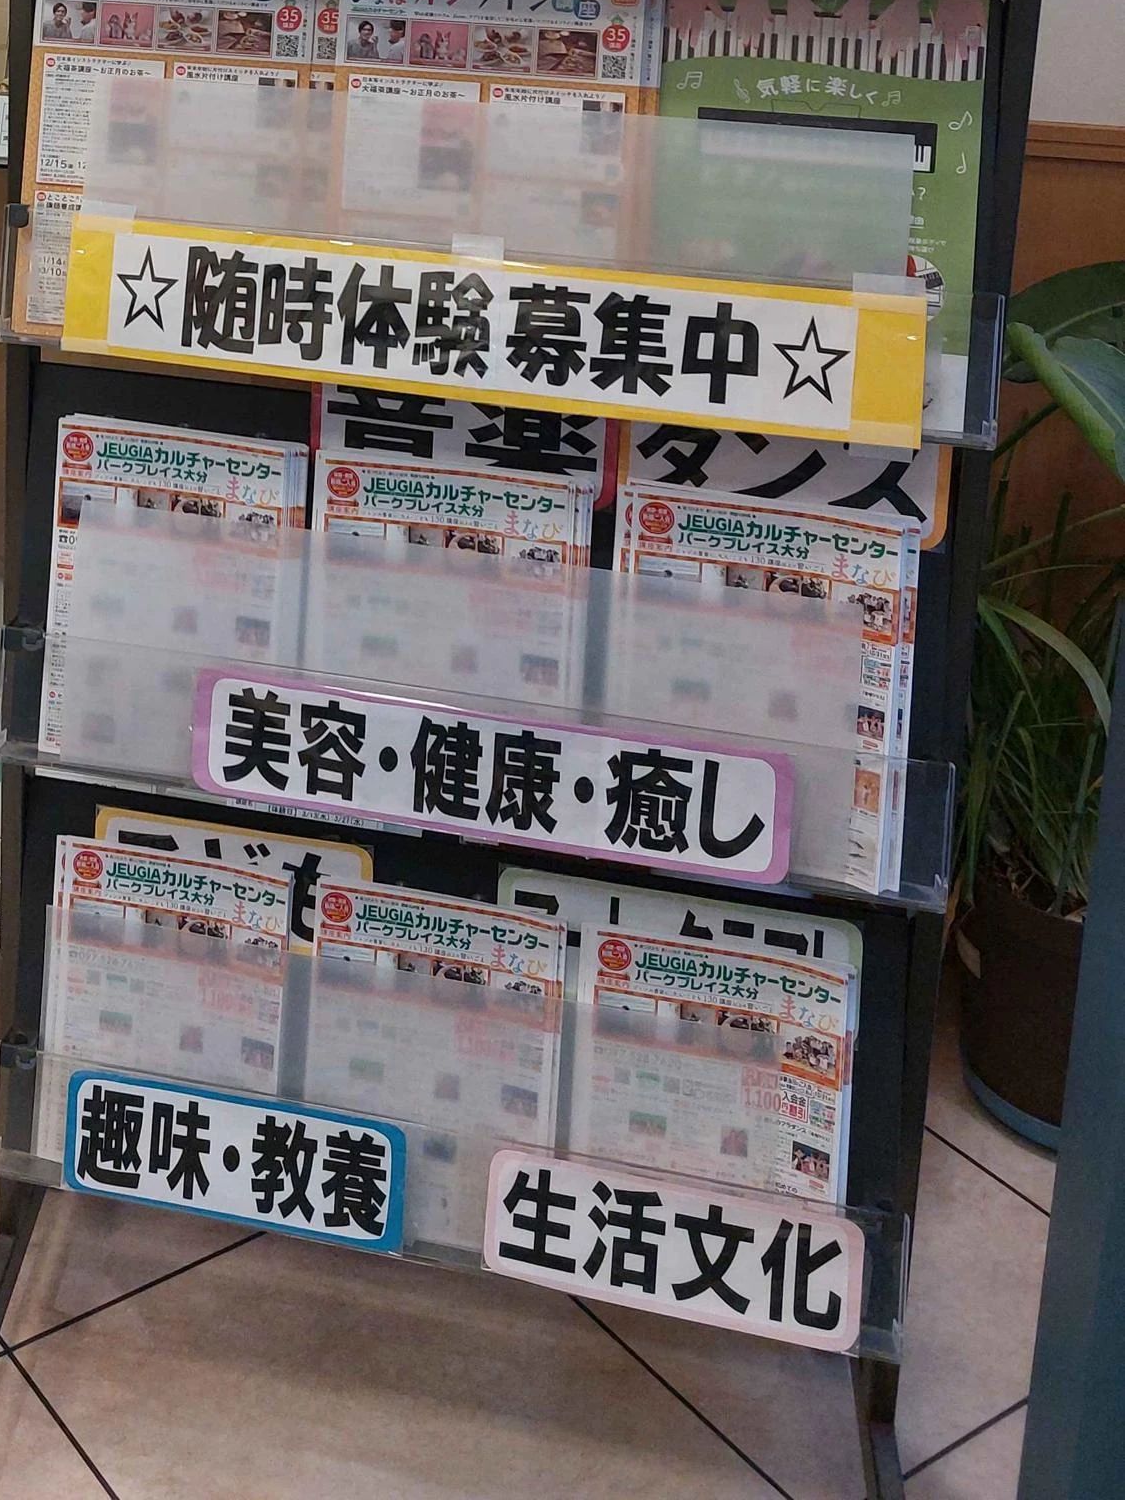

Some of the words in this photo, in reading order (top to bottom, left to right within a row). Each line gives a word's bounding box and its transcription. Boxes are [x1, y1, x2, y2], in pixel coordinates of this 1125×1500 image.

[280, 9, 299, 22] 35
[607, 28, 626, 41] 35
[756, 74, 877, 106] 気軽に楽しく
[182, 244, 759, 406] 随時体験募集中
[96, 442, 282, 481] JEUGIAカルチャーセンター
[96, 458, 208, 484] パークプレイス大分
[363, 477, 566, 514] JEUGIAカルチャーセンター
[363, 495, 484, 518] パークプレイス大分
[678, 513, 899, 559] JEUGIAカルチャーセンター
[678, 532, 809, 560] パークプレイス大分
[221, 689, 765, 861] 美容・健康・癒し
[106, 862, 286, 907] JEUGIAカルチャーセンター
[106, 878, 215, 906] パークプレイス大分
[355, 903, 550, 950] JEUGIAカルチャーセンター
[355, 921, 471, 950] パークプレイス大分
[635, 951, 842, 1004] JEUGIAカルチャーセンター
[635, 970, 759, 1000] パークプレイス大分
[75, 1083, 390, 1238] 趣味・教養
[497, 1169, 843, 1331] 生活文化
